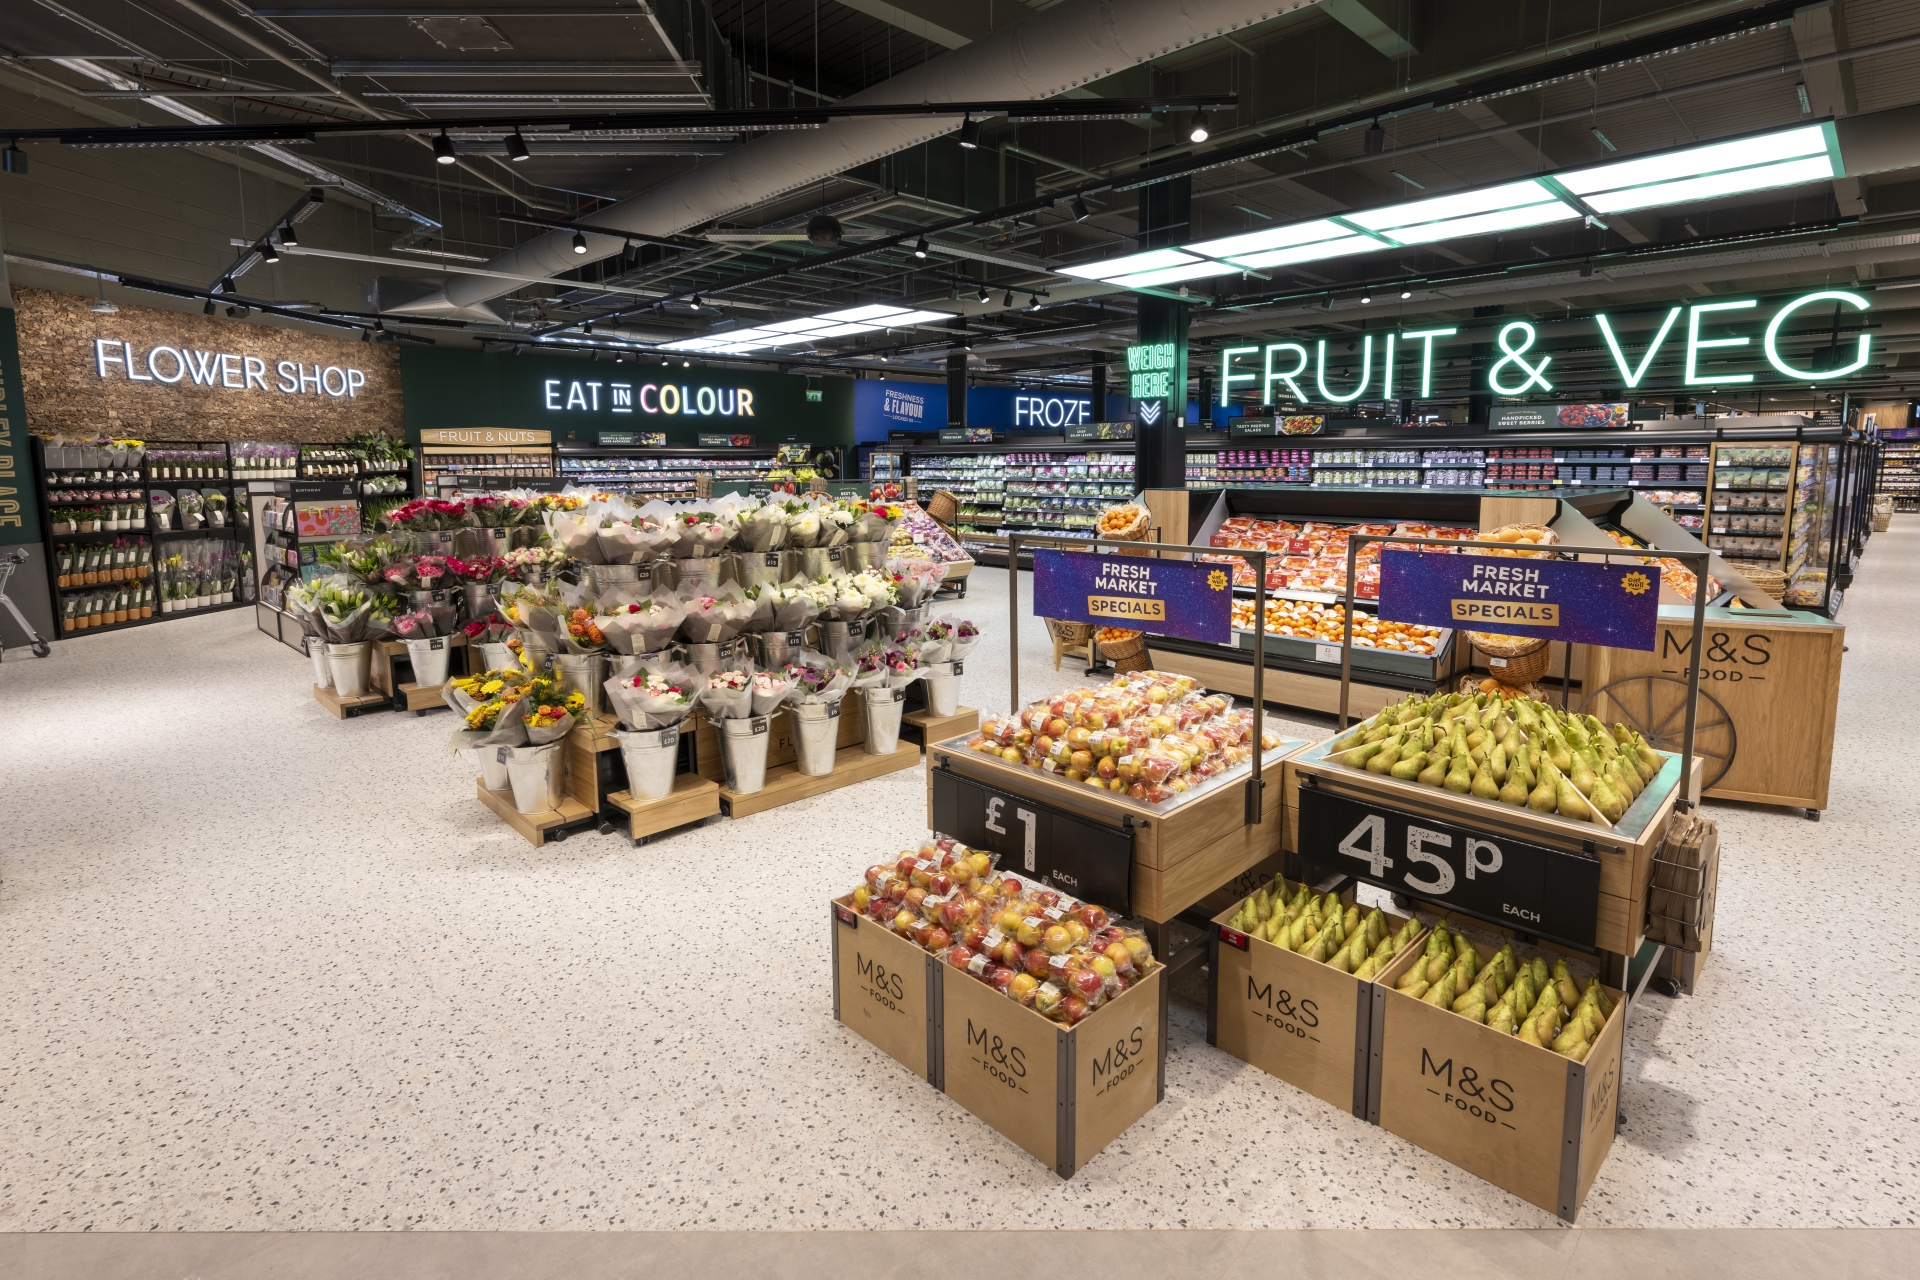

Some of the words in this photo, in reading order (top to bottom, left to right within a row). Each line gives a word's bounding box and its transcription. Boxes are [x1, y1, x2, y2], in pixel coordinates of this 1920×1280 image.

[1127, 343, 1175, 371] WEIGH
[1220, 327, 1458, 408] FRUIT
[1488, 321, 1554, 395] &
[1595, 290, 1871, 388] VEG
[94, 338, 268, 391] FLOWER
[276, 360, 365, 397] SHOP
[545, 379, 602, 411] EAT
[613, 389, 631, 406] IN
[640, 384, 755, 417] COLOUR
[885, 389, 924, 405] FRESHNESS
[1132, 372, 1169, 398] HERE
[883, 398, 890, 412] &
[891, 399, 923, 418] FLAVOUR
[440, 431, 481, 442] FRUIT
[485, 432, 495, 442] &
[498, 431, 535, 442] NUTS
[1102, 562, 1150, 580] FRESH
[1473, 564, 1539, 583] FRESH
[1095, 576, 1157, 596] MARKET
[1462, 578, 1549, 599] MARKET
[1091, 599, 1161, 616] SPECIALS
[1456, 603, 1553, 621] SPECIALS
[1662, 629, 1772, 666] M&S
[1683, 667, 1743, 682] FOOD
[664, 737, 675, 745] £20
[754, 725, 765, 733] £20
[985, 796, 1037, 873] £1
[1338, 813, 1503, 895] 45p
[1052, 869, 1078, 887] EACH
[1502, 903, 1541, 923] EACH
[857, 951, 904, 1000] M&S
[869, 988, 896, 1012] FOOD
[1247, 975, 1319, 1028] M&S
[1265, 1013, 1306, 1039] FOOD
[967, 1018, 1027, 1078] M&S
[1092, 1026, 1143, 1087] M&S
[983, 1061, 1017, 1090] FOOD
[1106, 1063, 1135, 1091] FOOD
[1420, 1047, 1515, 1112] M&S
[1590, 1057, 1615, 1123] M&S
[1444, 1092, 1497, 1124] FOOD
